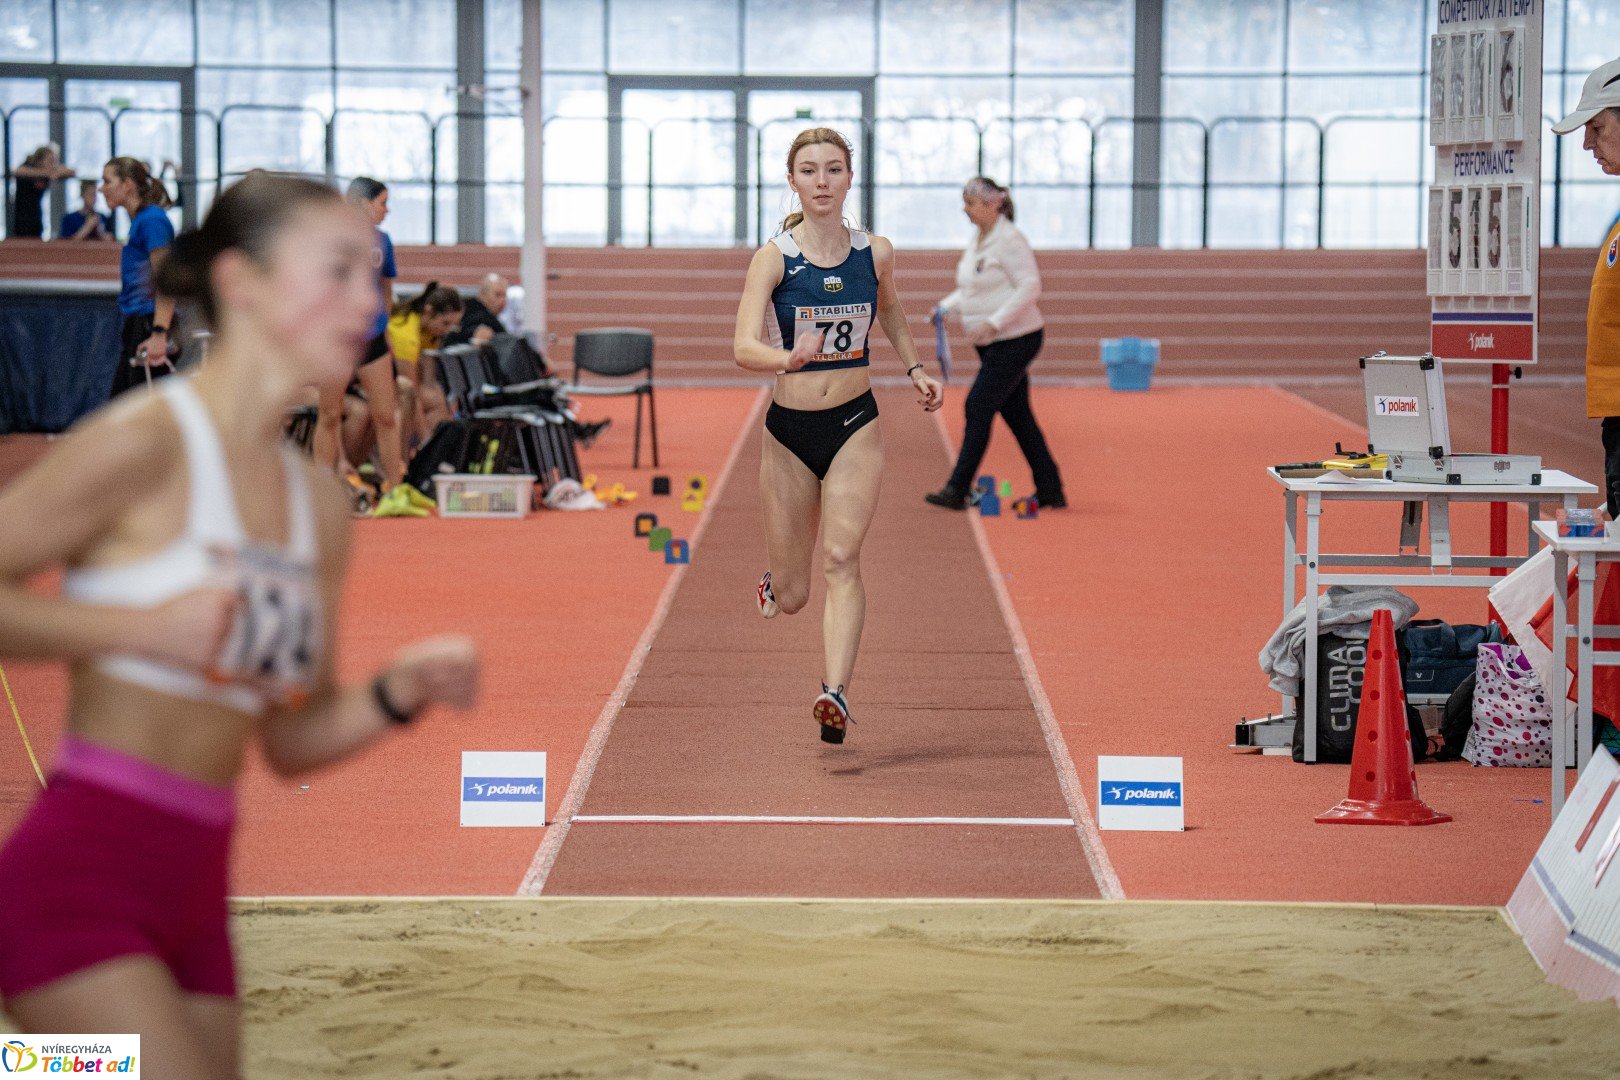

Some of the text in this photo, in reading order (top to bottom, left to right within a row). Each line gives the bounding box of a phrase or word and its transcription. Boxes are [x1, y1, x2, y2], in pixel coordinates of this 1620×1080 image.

[1439, 0, 1490, 24] COMPETITOR
[1454, 149, 1515, 176] PERFORMANCE
[814, 305, 867, 315] STABILITA
[815, 320, 853, 353] 78
[1388, 398, 1417, 414] polanik
[487, 784, 538, 797] polanik
[1125, 788, 1175, 800] polanik
